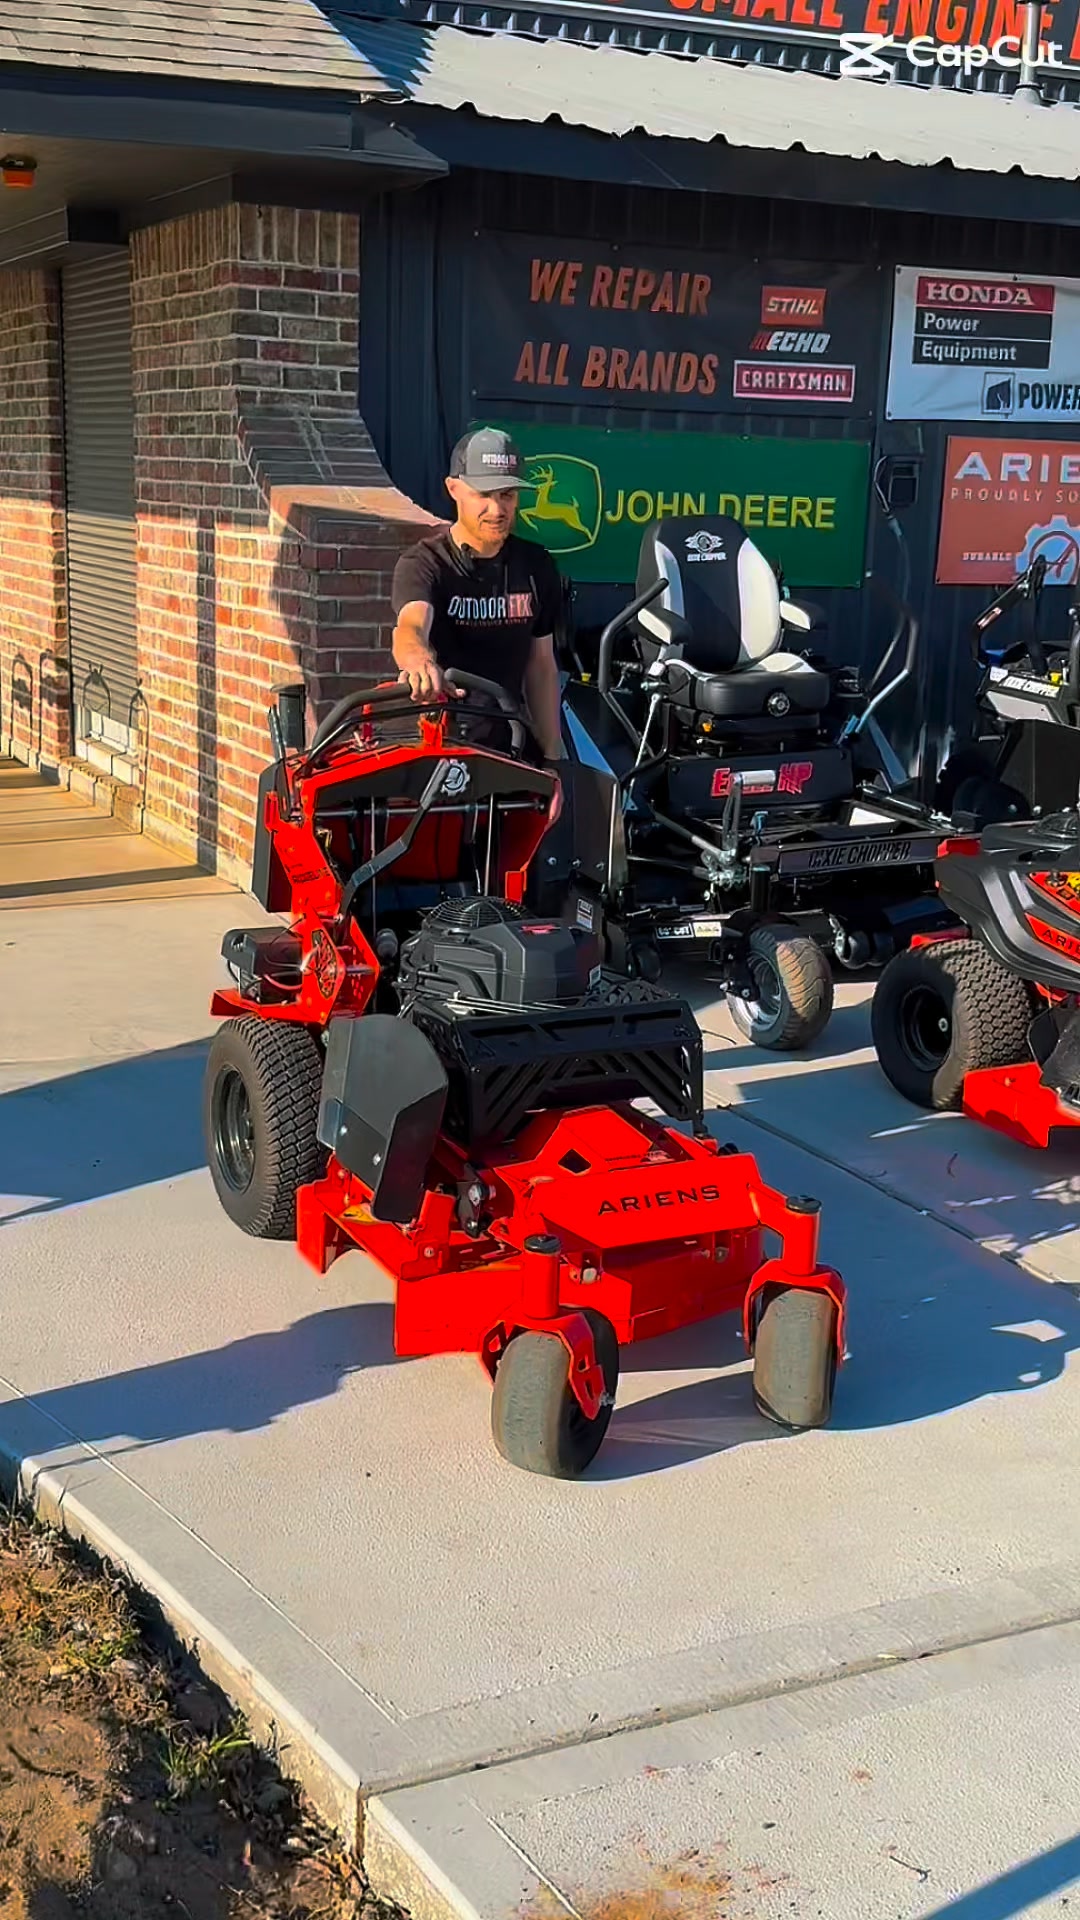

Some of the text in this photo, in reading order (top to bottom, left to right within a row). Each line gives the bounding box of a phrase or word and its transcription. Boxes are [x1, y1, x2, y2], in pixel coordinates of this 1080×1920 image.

[530, 259, 711, 315] WE REPAIR
[926, 282, 1035, 306] HONDA
[767, 297, 819, 315] STIHL
[924, 312, 980, 331] Power
[766, 331, 831, 353] ECHO
[922, 341, 1017, 362] Equipment
[514, 342, 719, 394] ALL BRANDS
[741, 370, 847, 391] CRAFTSMAN
[951, 488, 1042, 502] PROUDLY
[605, 489, 837, 528] JOHN DEERE
[447, 595, 507, 619] OUTDOOR
[598, 1185, 721, 1216] ARIENS
